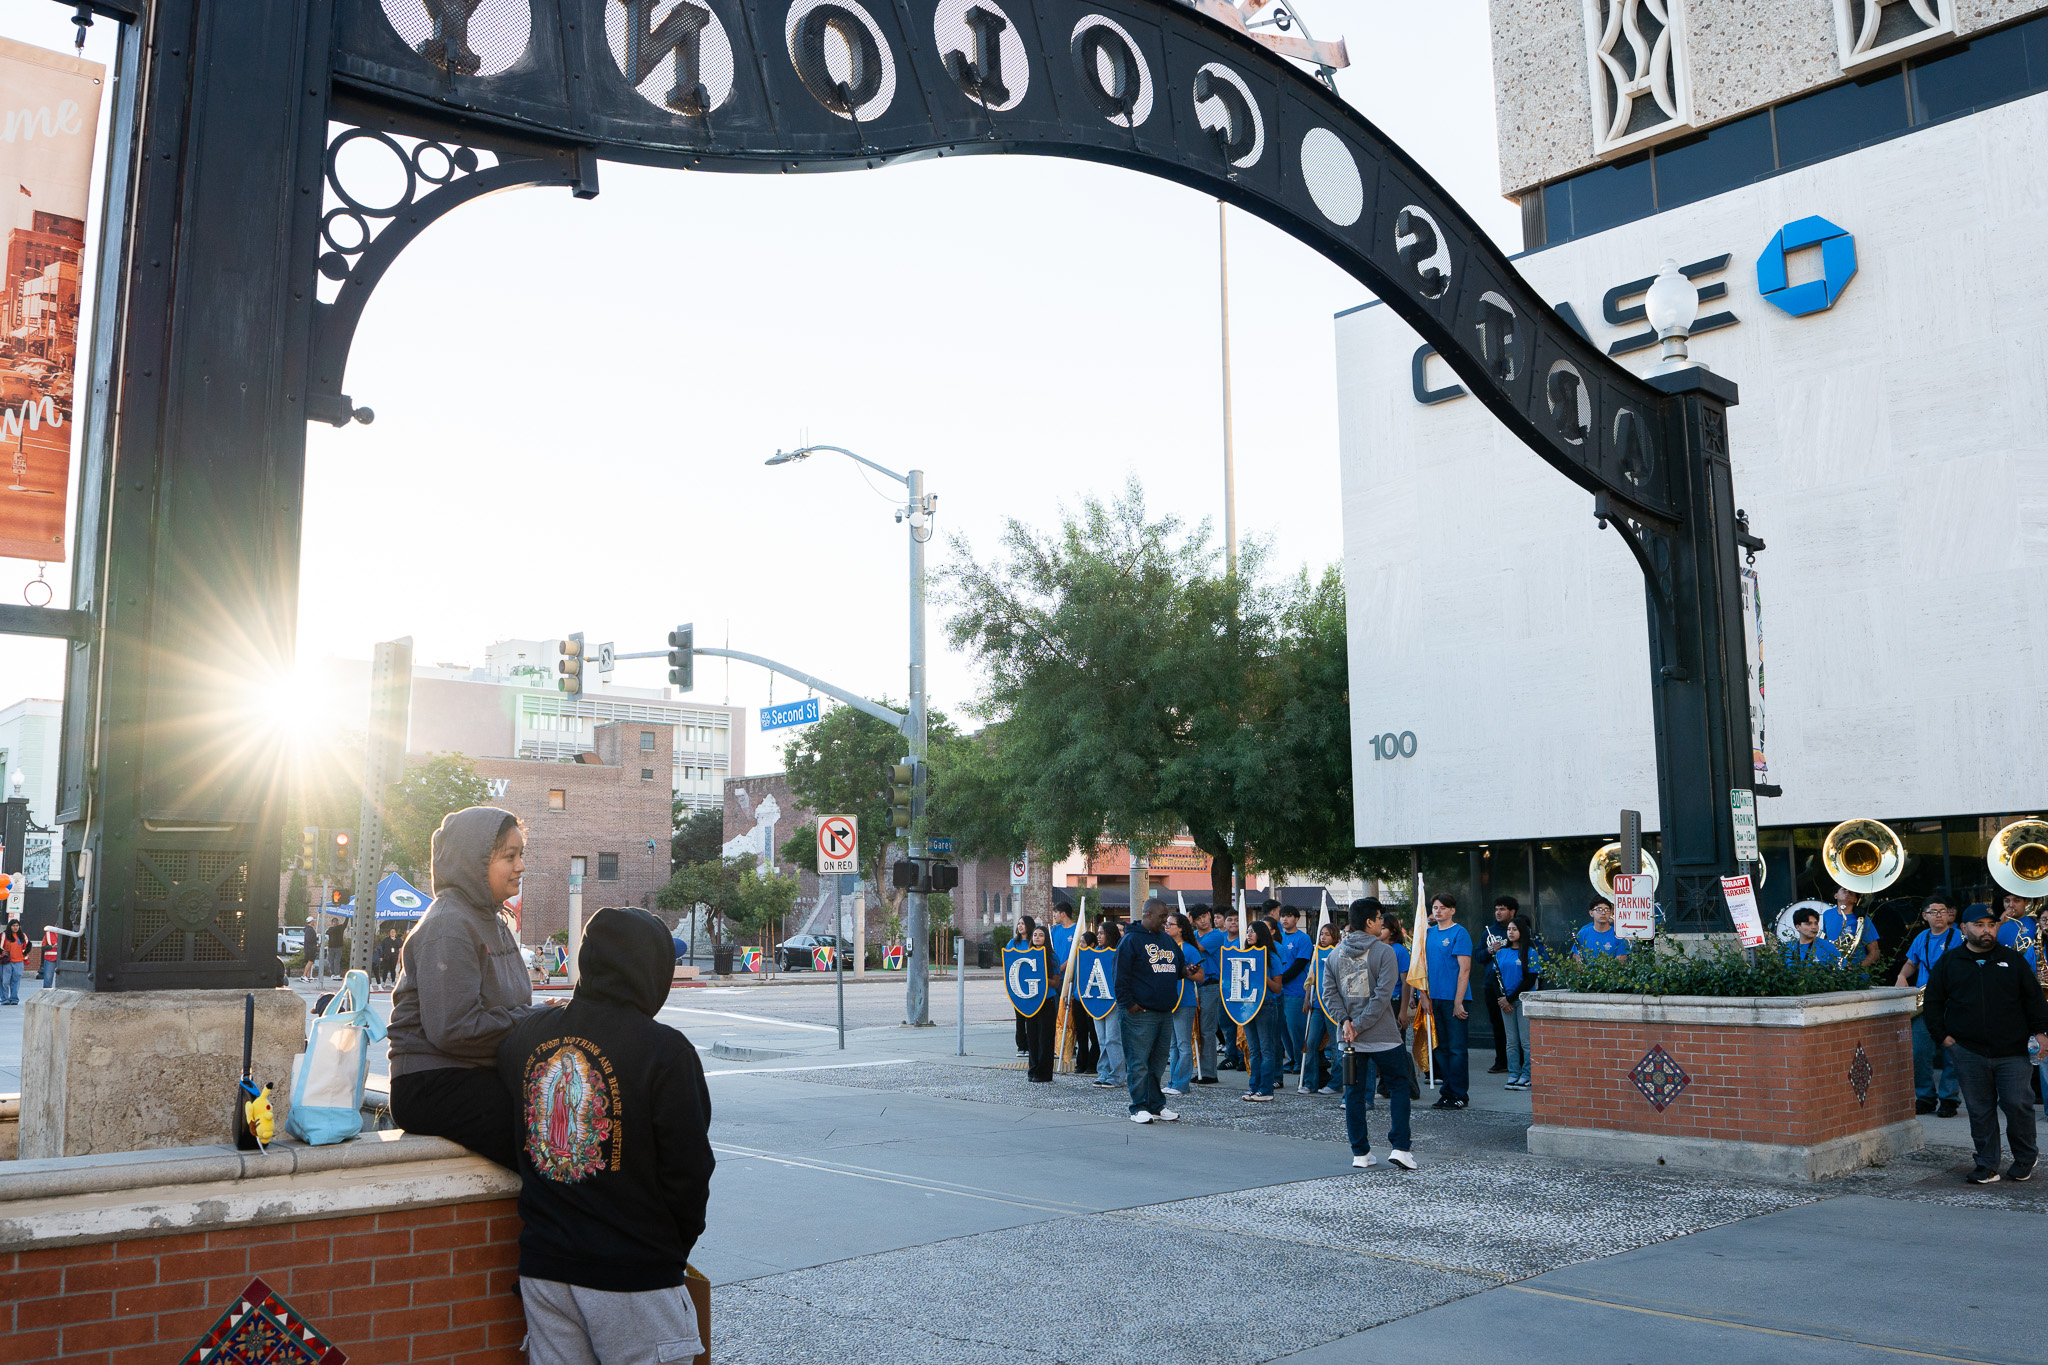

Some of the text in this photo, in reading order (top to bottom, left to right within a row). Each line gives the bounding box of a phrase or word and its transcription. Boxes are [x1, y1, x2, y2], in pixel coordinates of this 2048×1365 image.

[772, 702, 817, 725] Second St
[1369, 730, 1418, 761] 100
[1732, 791, 1740, 807] 30
[1734, 813, 1754, 827] PARKING
[824, 861, 853, 870] ON RED
[1616, 877, 1631, 892] NO
[1617, 896, 1651, 909] PARKING
[1618, 911, 1651, 920] ANY TIME
[1008, 957, 1042, 999] G
[1080, 957, 1115, 1000] A
[1225, 957, 1258, 1003] E
[535, 1037, 560, 1056] FROM
[562, 1036, 601, 1056] NOTHING
[598, 1056, 614, 1075] AND
[607, 1075, 622, 1116] BECAME
[610, 1119, 622, 1172] SOMETHING
